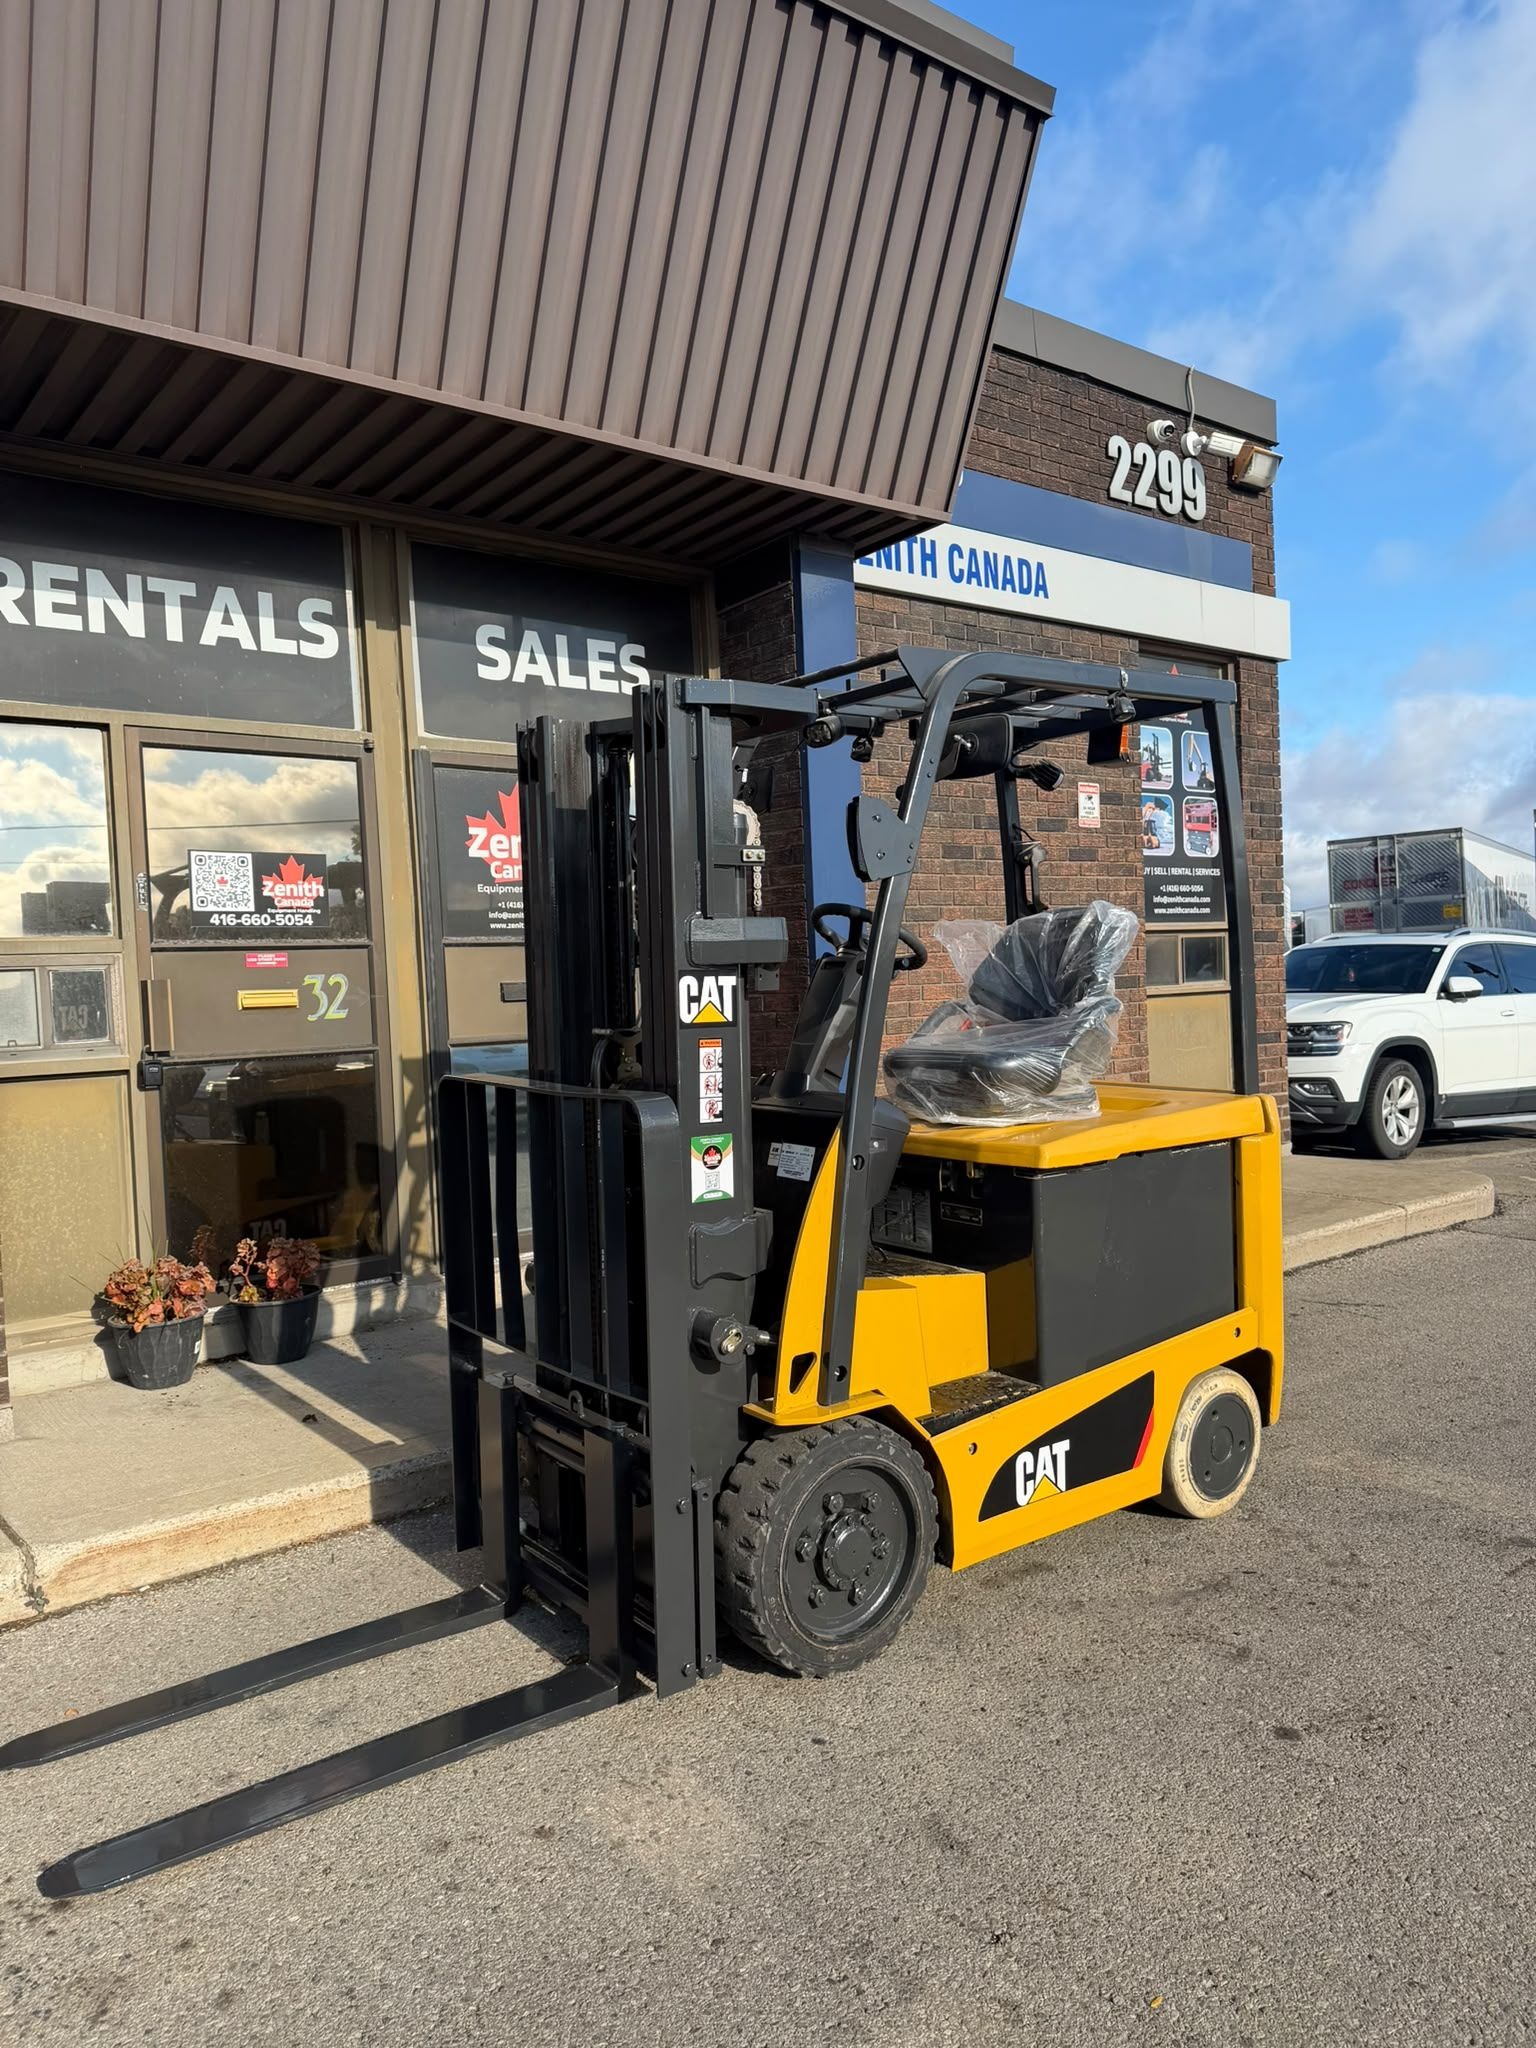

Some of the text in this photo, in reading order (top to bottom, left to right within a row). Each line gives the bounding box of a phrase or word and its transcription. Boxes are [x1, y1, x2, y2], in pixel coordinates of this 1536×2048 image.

[1107, 434, 1207, 521] 2299
[855, 536, 1050, 590] NITH CANADA
[475, 623, 650, 697] SALES
[468, 826, 522, 859] Zen
[262, 880, 325, 898] Zenith
[490, 861, 523, 879] Can
[1153, 866, 1168, 876] SELL
[1171, 866, 1192, 876] RENTAL
[1195, 867, 1221, 877] SERVICES
[209, 913, 314, 927] 416-660-5054
[273, 896, 315, 908] Canada
[302, 973, 349, 1022] 32
[678, 975, 737, 1024] CAT
[1015, 1438, 1070, 1507] CAT
